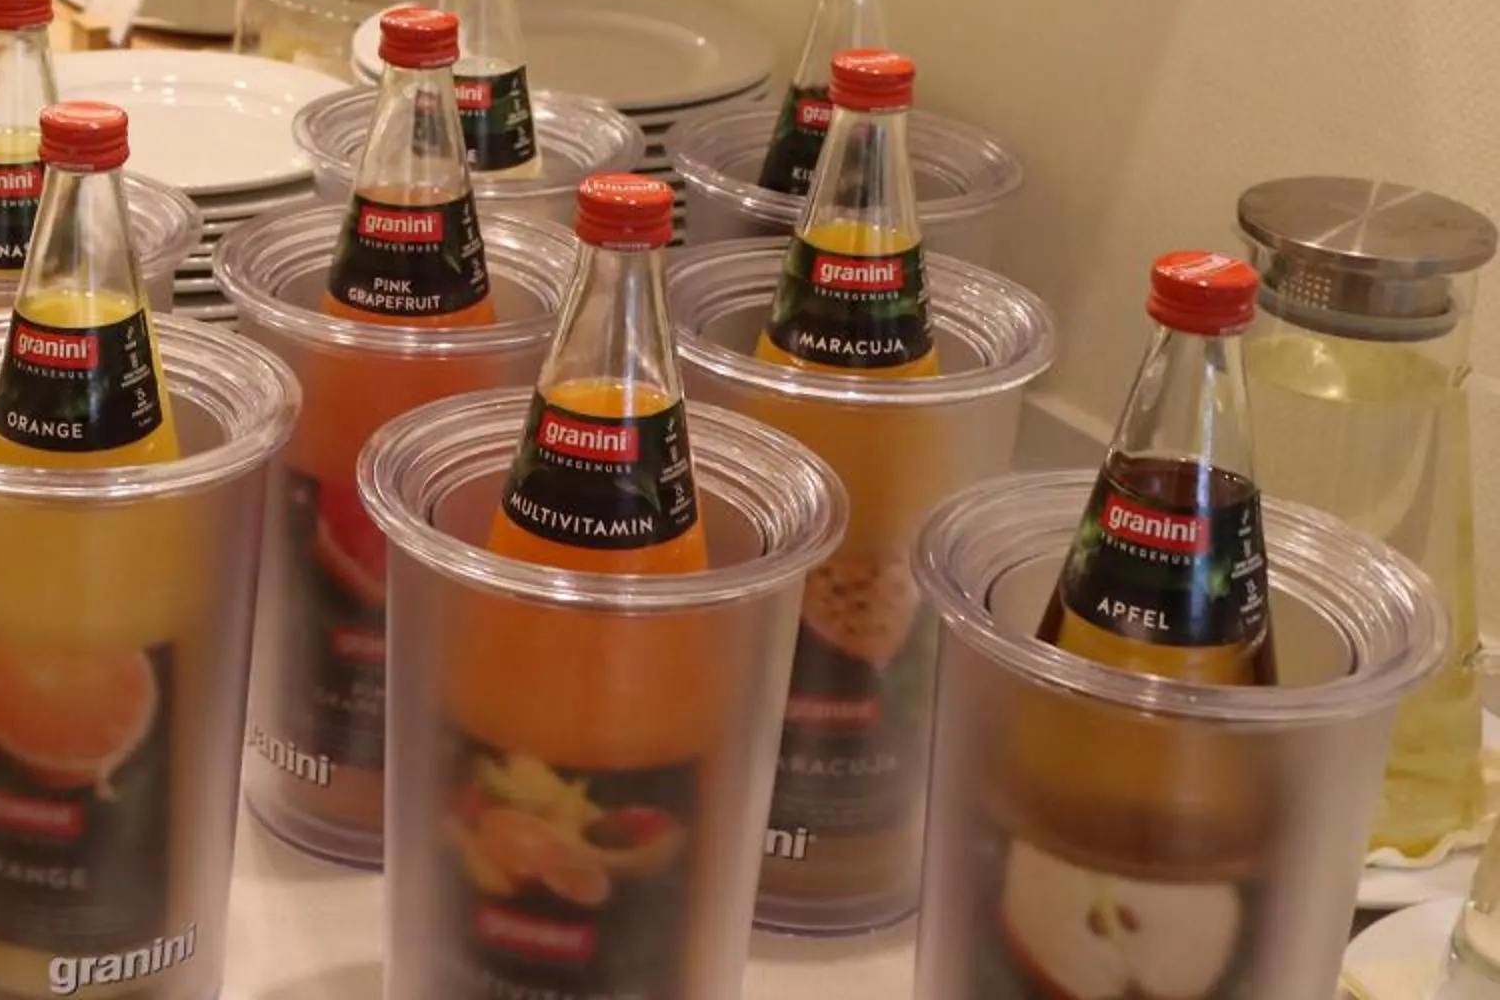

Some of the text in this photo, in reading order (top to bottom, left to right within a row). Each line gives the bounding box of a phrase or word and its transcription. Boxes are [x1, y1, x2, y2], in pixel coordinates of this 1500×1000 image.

[365, 213, 433, 233] granini
[374, 277, 412, 294] PINK
[820, 262, 895, 283] granini
[348, 287, 441, 311] GRAPEFRUIT
[18, 334, 88, 359] granini
[799, 332, 905, 356] MARACUJA
[7, 411, 84, 439] ORANGE
[545, 421, 627, 451] granini
[510, 492, 654, 537] MULTIVITAMIN
[1108, 505, 1198, 542] granini
[1097, 597, 1171, 631] APFEL
[248, 719, 330, 787] ranini
[48, 924, 197, 995] granini
